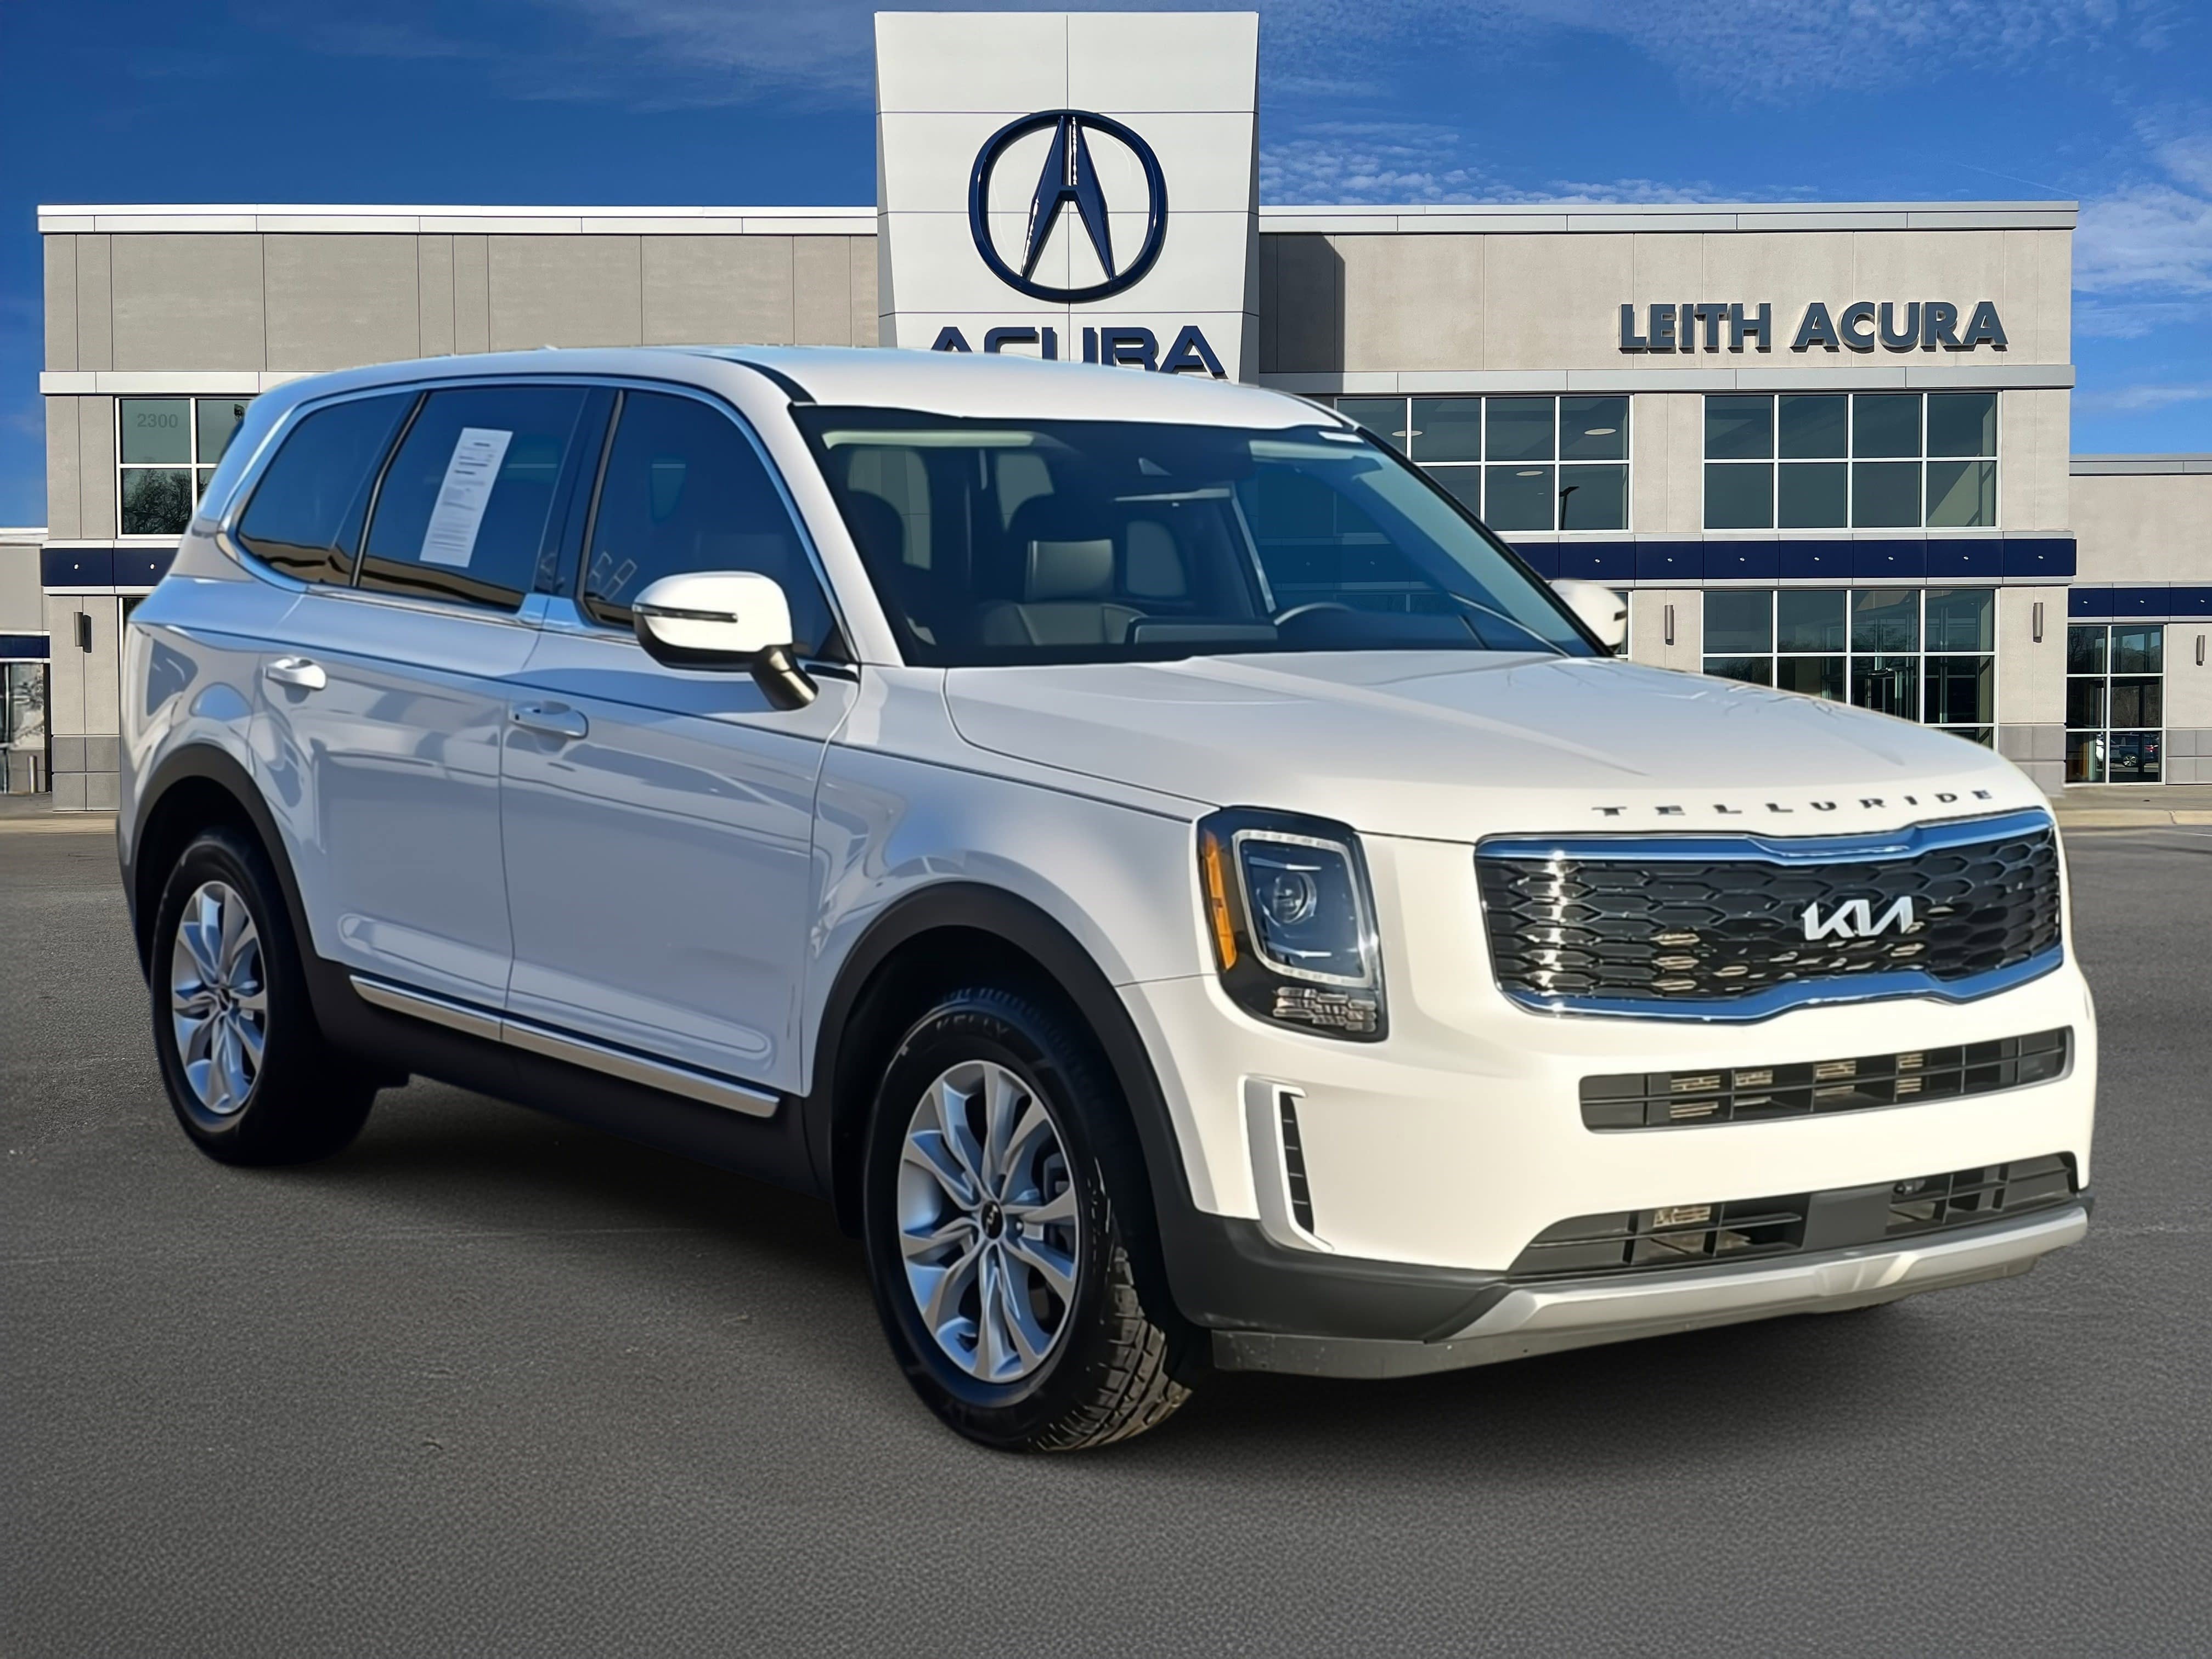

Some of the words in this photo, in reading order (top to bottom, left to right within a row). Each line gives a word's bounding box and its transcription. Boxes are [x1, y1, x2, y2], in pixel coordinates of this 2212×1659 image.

[1619, 303, 1771, 353] LEITH
[1790, 301, 2008, 353] ACURA
[137, 413, 178, 428] 2300
[1592, 790, 1993, 817] TELLURIDE
[1801, 895, 1914, 940] KIA
